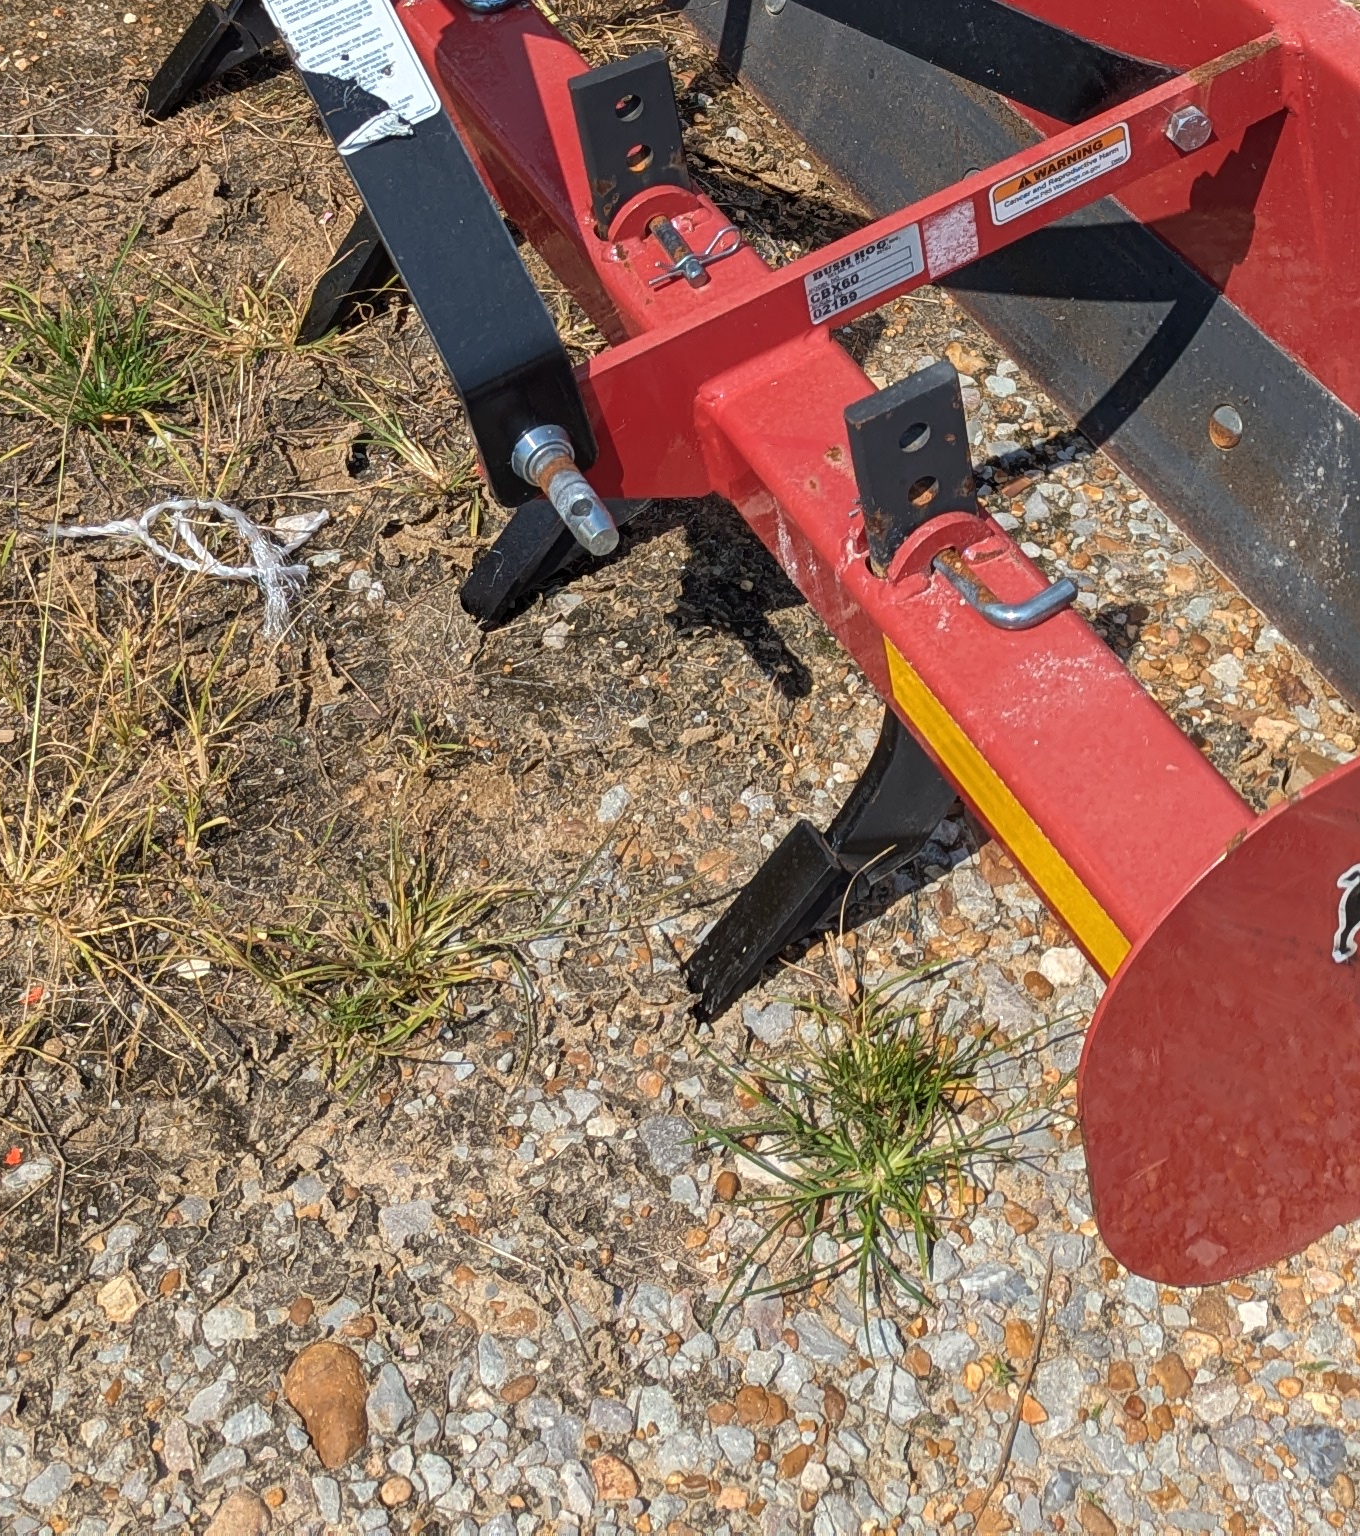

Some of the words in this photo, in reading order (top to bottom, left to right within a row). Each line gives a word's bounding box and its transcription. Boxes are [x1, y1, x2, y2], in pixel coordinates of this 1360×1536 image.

[1033, 138, 1103, 181] WARNING
[813, 255, 851, 281] BUSH
[855, 238, 888, 261] HOG
[810, 273, 859, 304] CBX60
[813, 291, 857, 319] 02189
